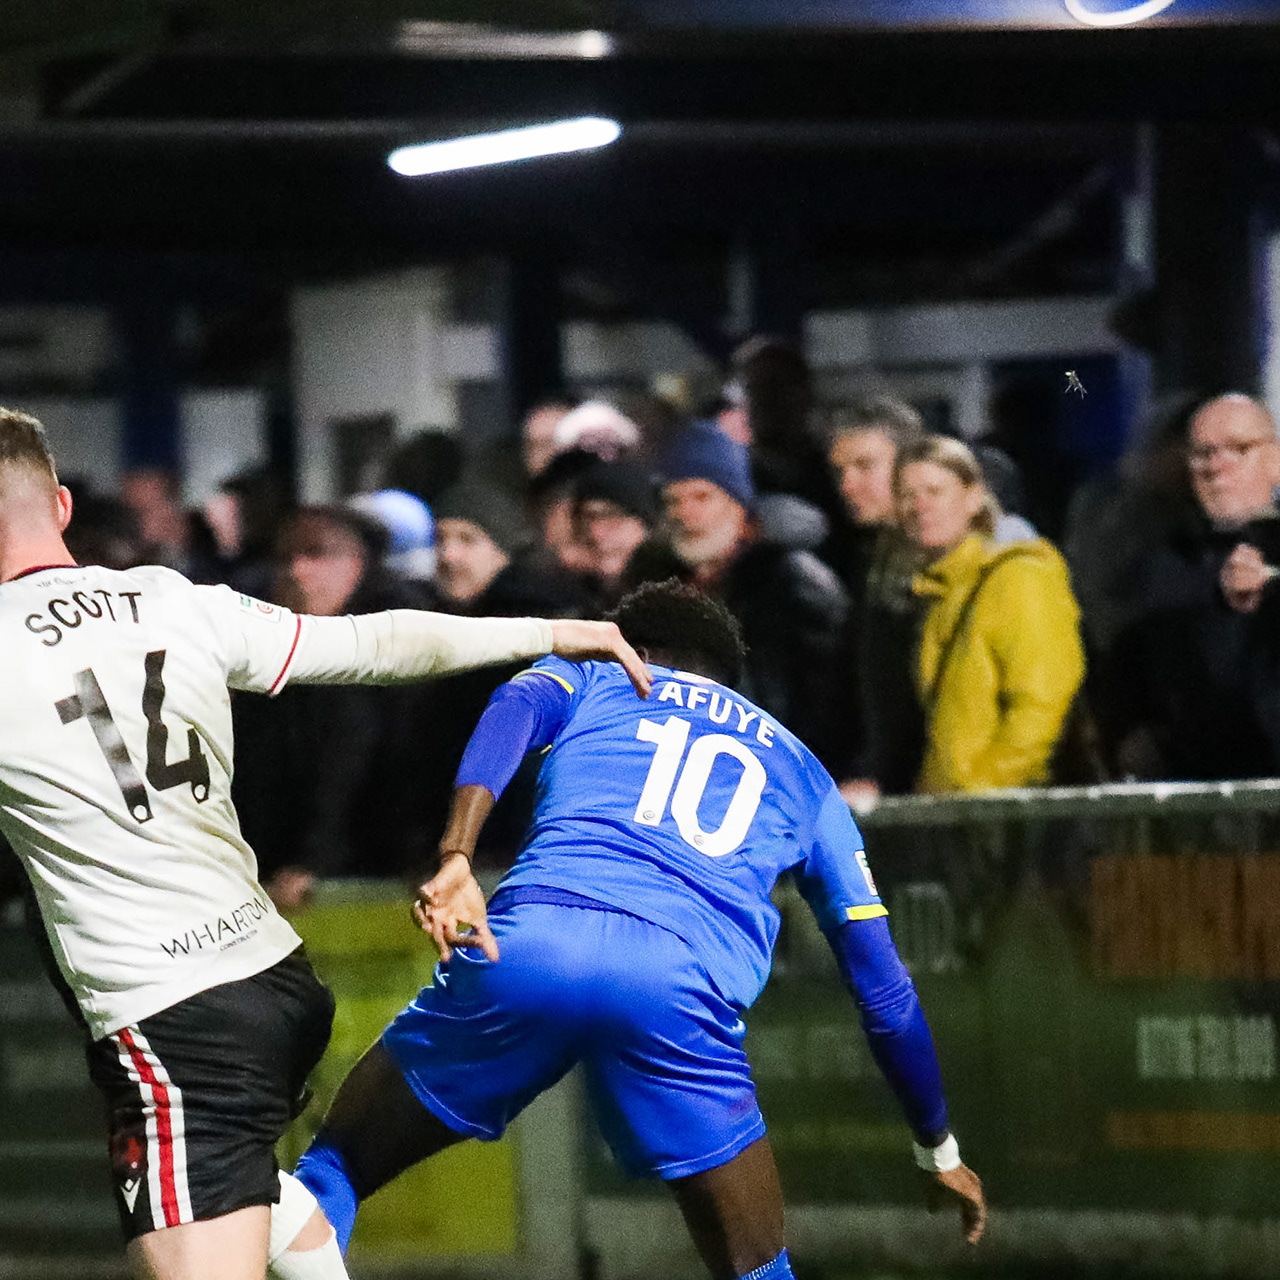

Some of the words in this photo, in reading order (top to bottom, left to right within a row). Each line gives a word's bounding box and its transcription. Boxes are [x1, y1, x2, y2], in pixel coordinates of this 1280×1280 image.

[25, 590, 142, 647] SCOTT
[53, 650, 211, 824] 14
[658, 681, 776, 749] AFUYE
[634, 714, 767, 858] 10
